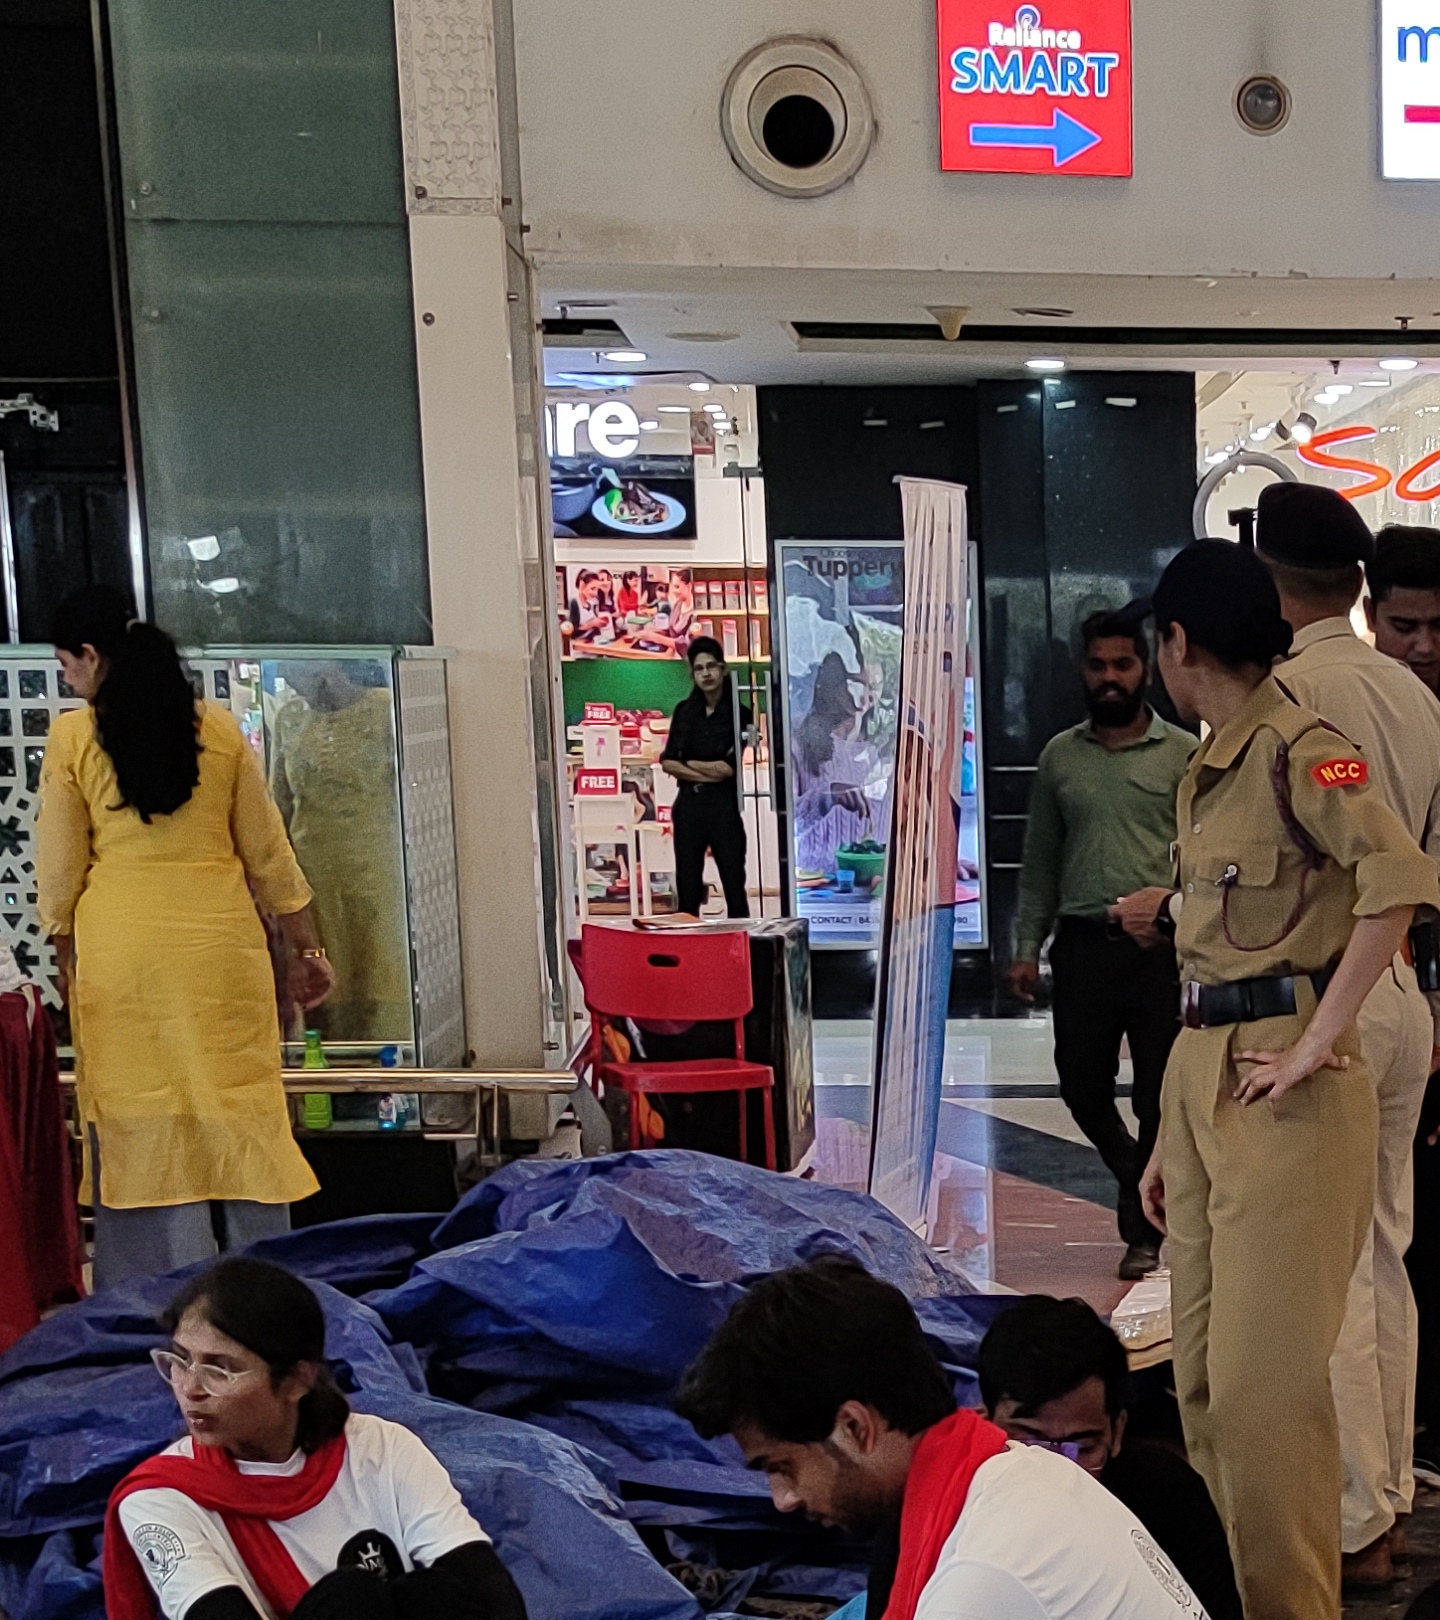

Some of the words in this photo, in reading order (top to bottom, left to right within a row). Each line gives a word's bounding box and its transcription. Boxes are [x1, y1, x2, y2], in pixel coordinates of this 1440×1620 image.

[988, 22, 1081, 49] Reliance
[951, 47, 1119, 97] SMART
[545, 401, 640, 458] re
[803, 555, 896, 581] Tupper
[581, 775, 616, 789] FREE
[1320, 763, 1360, 782] NCC
[810, 916, 852, 925] CONTACT
